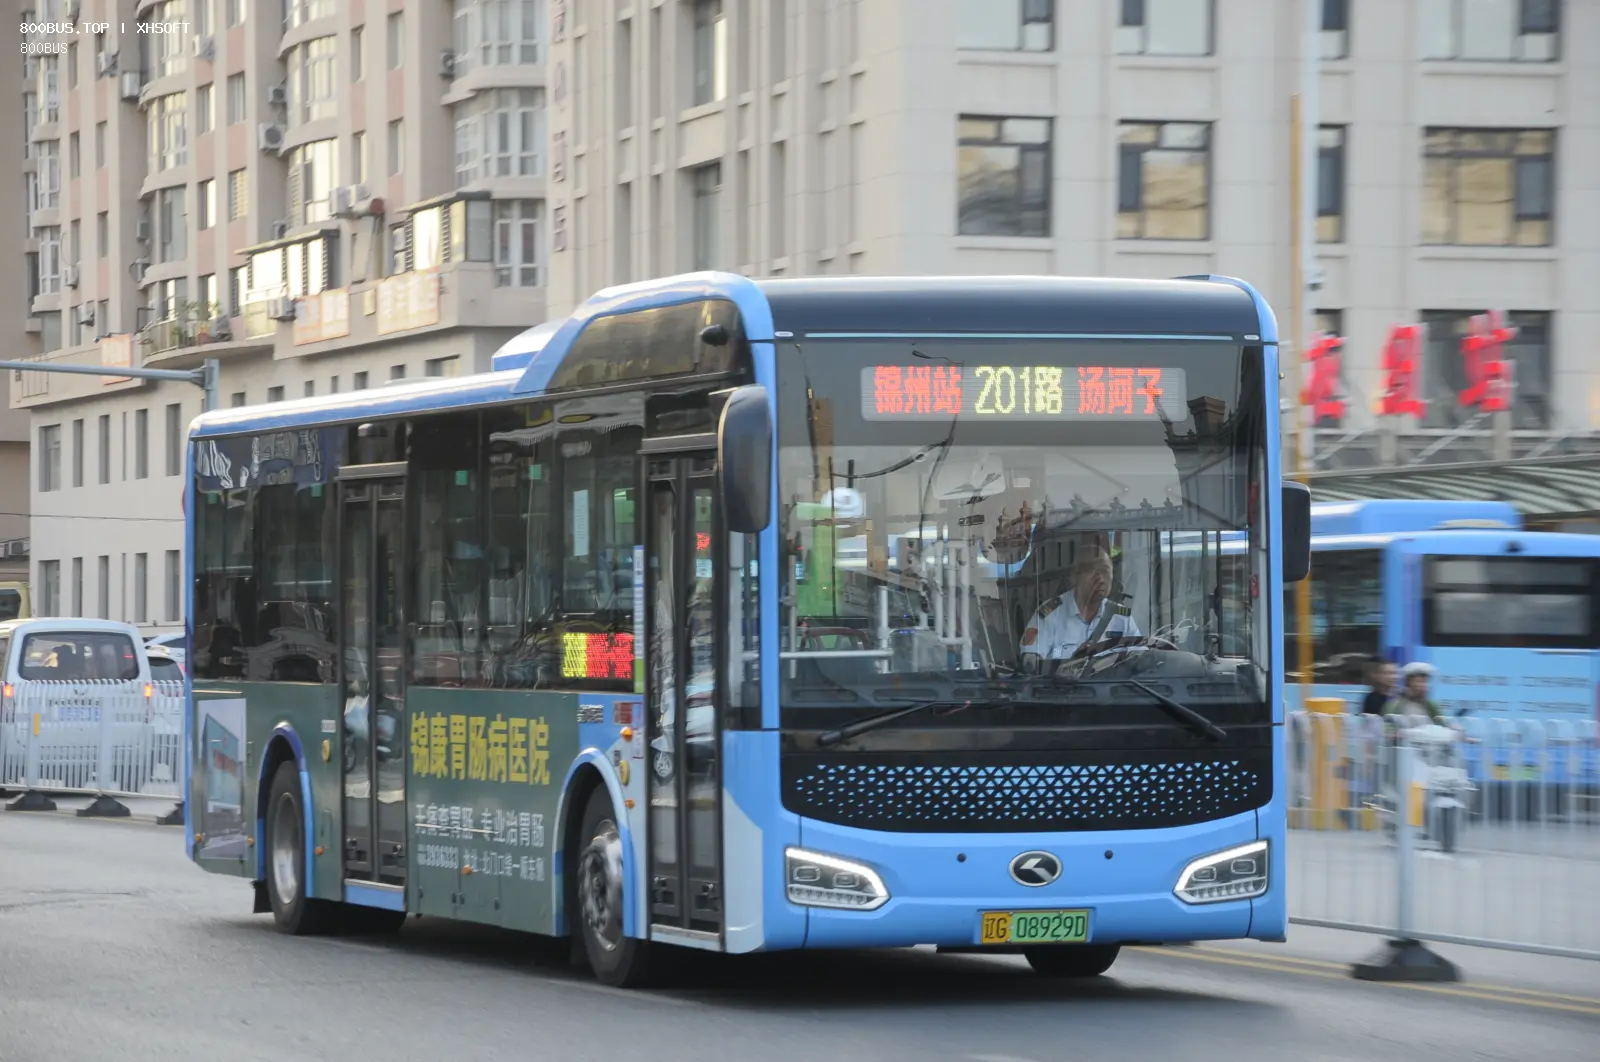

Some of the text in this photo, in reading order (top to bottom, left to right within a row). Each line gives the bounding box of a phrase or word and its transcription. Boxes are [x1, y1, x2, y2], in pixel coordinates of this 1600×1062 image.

[973, 365, 1064, 415] 201路
[1077, 366, 1164, 415] 汤河子
[409, 710, 551, 786] 锦康胃肠病医院
[984, 915, 1086, 939] 辽G 08929D
